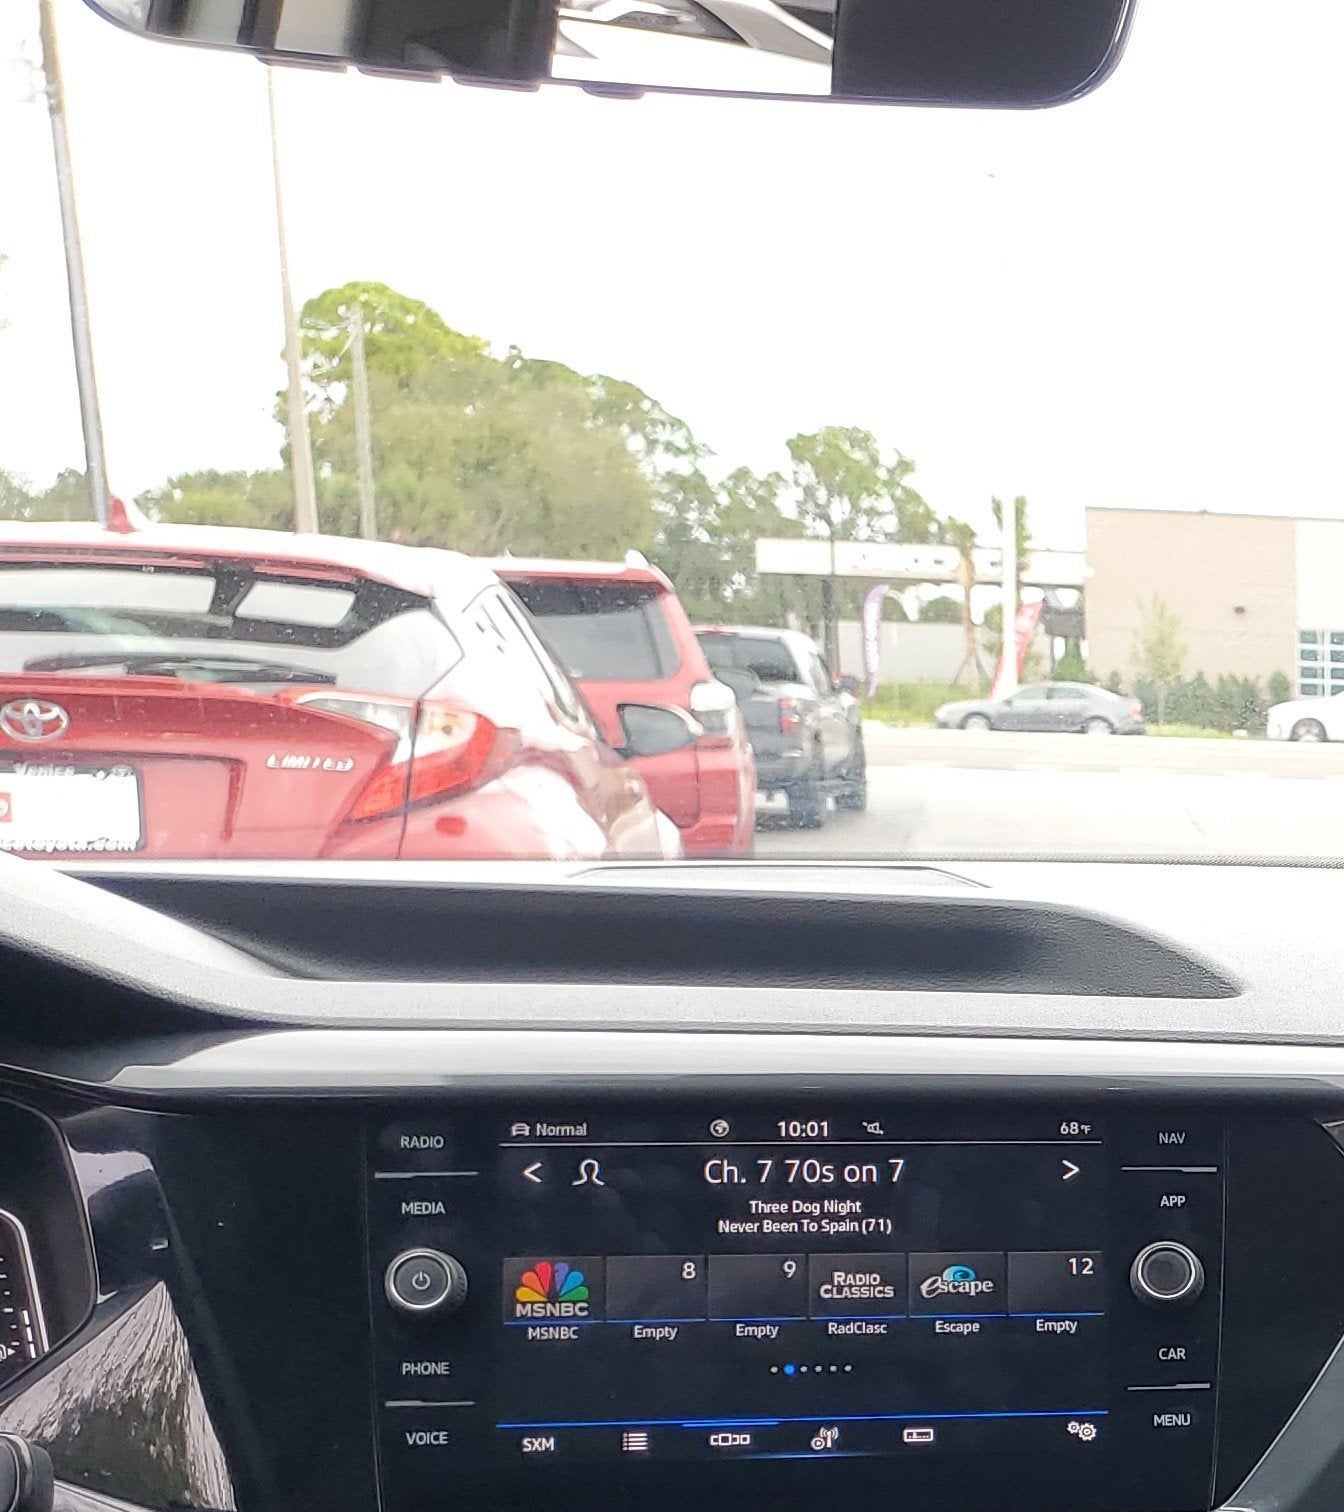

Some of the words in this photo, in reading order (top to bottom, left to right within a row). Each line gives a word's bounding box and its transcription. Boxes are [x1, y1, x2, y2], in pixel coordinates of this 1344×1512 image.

[536, 1122, 588, 1137] Normal
[777, 1121, 830, 1138] 10:01
[400, 1135, 445, 1150] RADIO
[1158, 1131, 1186, 1145] NAV
[703, 1158, 747, 1185] Ch.
[756, 1158, 774, 1184] 7
[784, 1158, 835, 1184] 70s
[843, 1164, 878, 1184] on
[887, 1158, 905, 1183] 7
[401, 1200, 447, 1215] MEDIA
[749, 1199, 789, 1215] Three
[791, 1199, 822, 1217] Dog
[823, 1199, 863, 1217] Night
[1160, 1194, 1187, 1208] APP
[718, 1219, 760, 1235] Never
[762, 1219, 799, 1235] Been
[800, 1219, 819, 1234] To
[820, 1218, 860, 1237] Spain
[861, 1218, 893, 1237] (71)
[681, 1261, 697, 1280] 8
[783, 1259, 797, 1279] 9
[1067, 1256, 1095, 1276] 12
[832, 1271, 881, 1286] RADIO
[819, 1284, 895, 1299] CLASSICS
[515, 1301, 590, 1318] MSNBC
[527, 1325, 580, 1341] MSNBC
[633, 1324, 679, 1341] Empty
[735, 1323, 780, 1339] Empty
[828, 1321, 889, 1336] RadClasc
[934, 1320, 981, 1336] Escape
[1036, 1318, 1079, 1335] Empty
[1158, 1347, 1187, 1361] CAR
[401, 1361, 451, 1376] PHONE
[1153, 1413, 1191, 1428] MENU
[405, 1430, 450, 1446] VOICE
[521, 1436, 555, 1452] SXM
